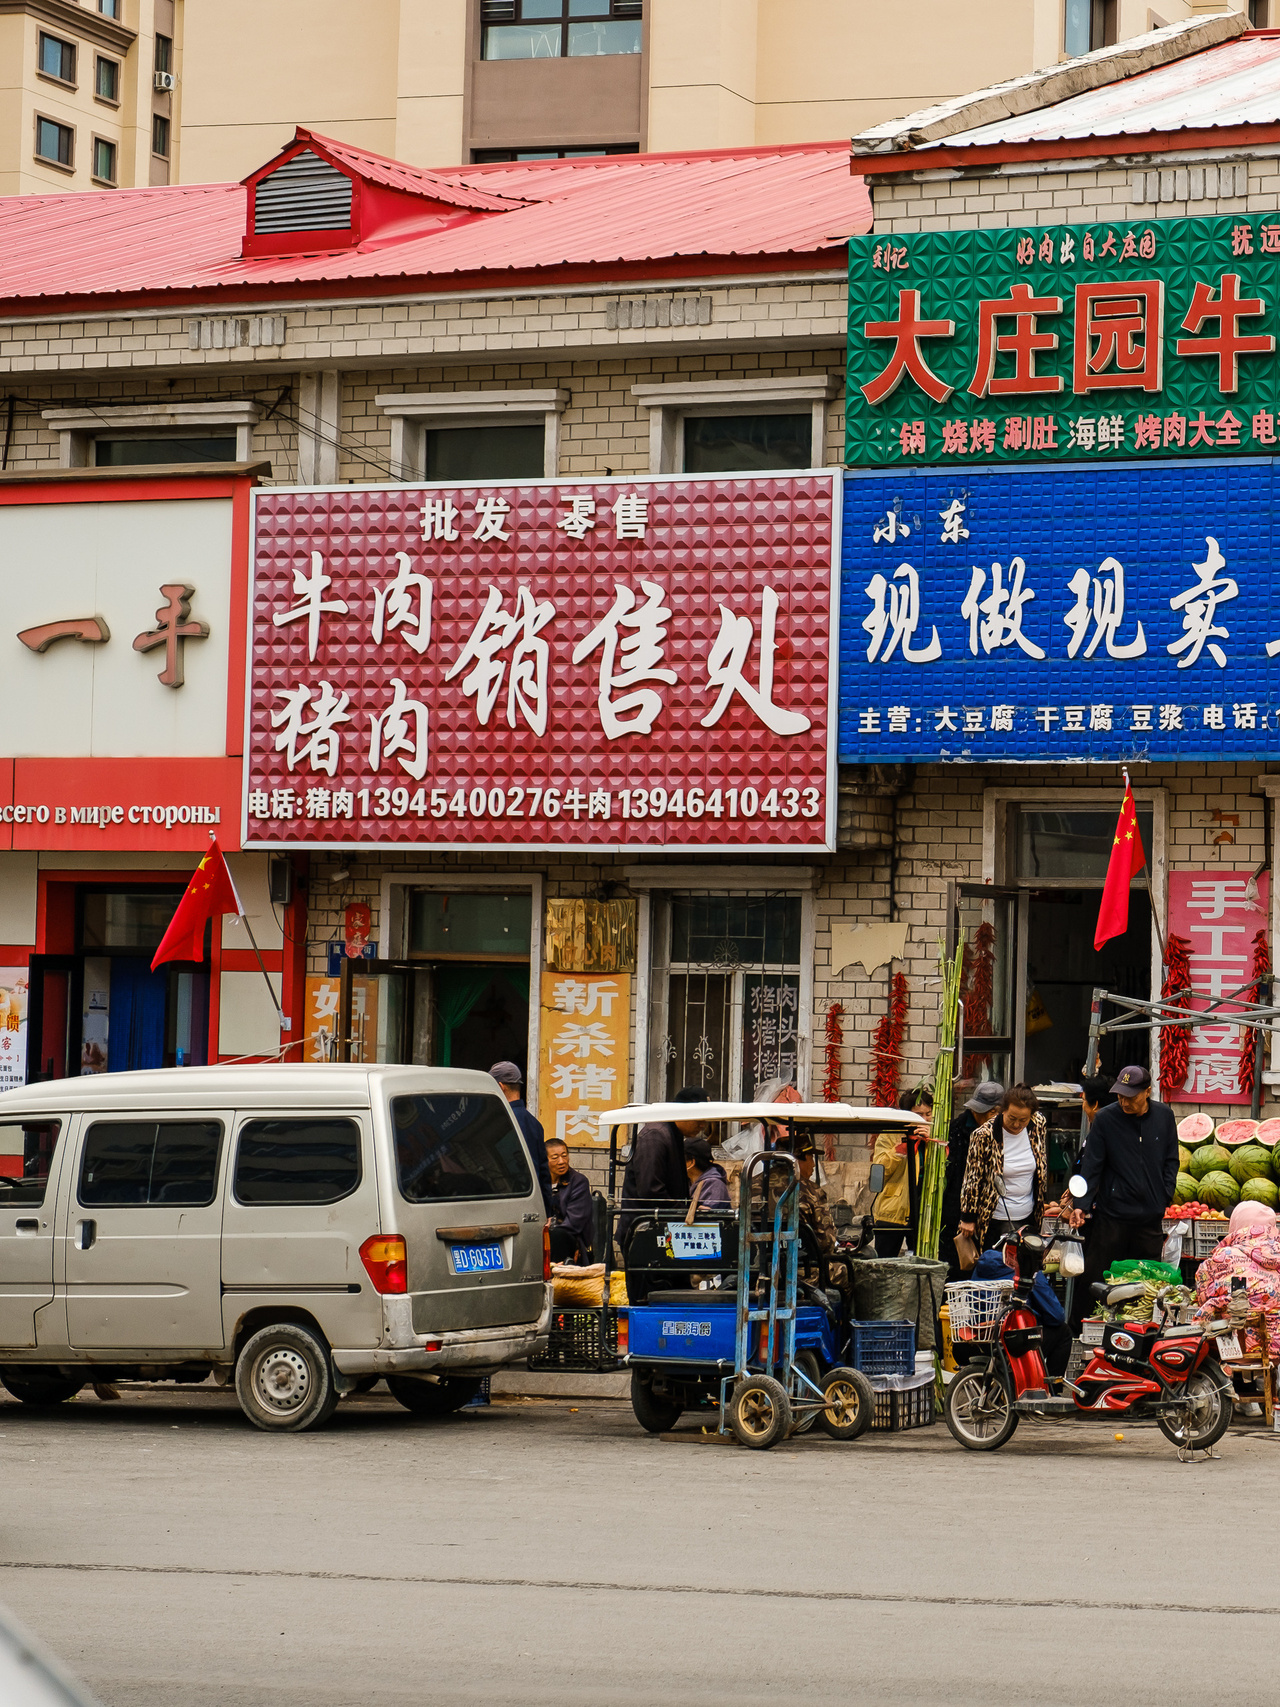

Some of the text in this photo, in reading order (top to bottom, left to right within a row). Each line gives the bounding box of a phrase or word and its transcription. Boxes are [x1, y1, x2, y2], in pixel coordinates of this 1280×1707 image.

[872, 243, 909, 272] 刘记
[1016, 229, 1157, 265] 好肉出自大庄园
[900, 421, 926, 455] 锅
[942, 419, 997, 454] 烧烤
[1067, 414, 1125, 451] 海鲜
[1134, 409, 1243, 449] 烤肉大全
[272, 550, 433, 662] 牛肉
[444, 580, 812, 740] 销售处
[269, 677, 430, 781] 猪肉
[1035, 704, 1113, 732] 干豆腐
[1129, 704, 1183, 732] 豆浆
[54, 806, 67, 823] в
[70, 805, 124, 828] мире
[128, 805, 221, 829] стороны
[751, 983, 798, 1014] 猪肉
[752, 1015, 798, 1046] 猪头
[550, 979, 619, 1143] 新杀猪肉
